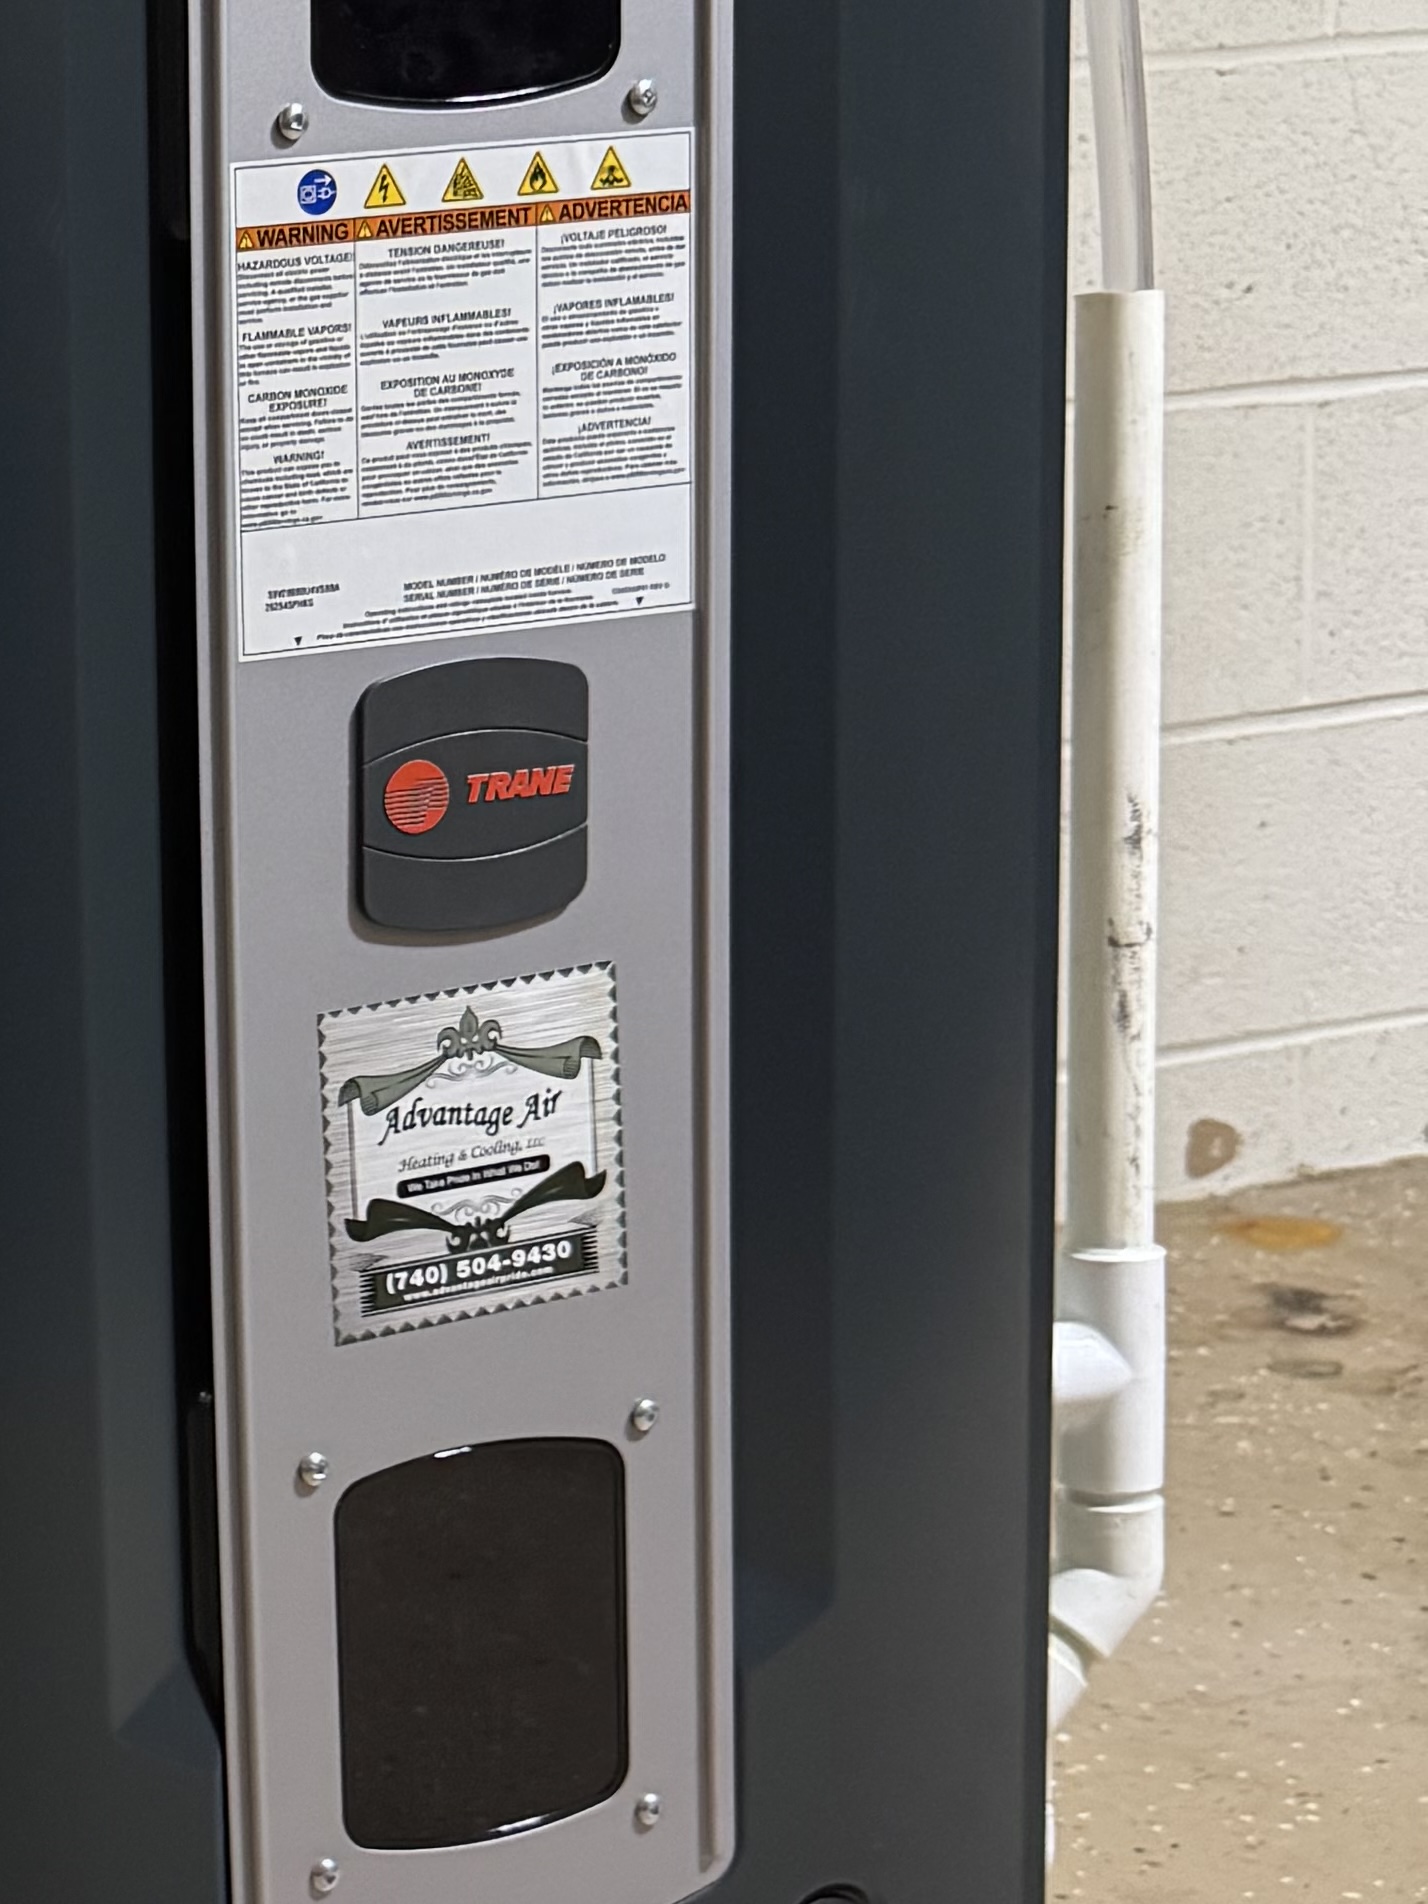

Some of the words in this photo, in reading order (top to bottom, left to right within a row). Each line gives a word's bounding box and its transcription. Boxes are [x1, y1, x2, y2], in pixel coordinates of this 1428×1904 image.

[376, 206, 532, 237] AVERTISSEMENT
[559, 194, 688, 221] ADVERTENCIA
[257, 223, 348, 246] WARNING
[466, 764, 575, 804] TRANE
[377, 1097, 513, 1146] Advantage
[517, 1088, 563, 1129] Air
[398, 1152, 454, 1173] Heating
[458, 1150, 468, 1160] &
[471, 1139, 523, 1160] Cooling,
[386, 1264, 448, 1294] (740)
[456, 1240, 572, 1278] 504-9430
